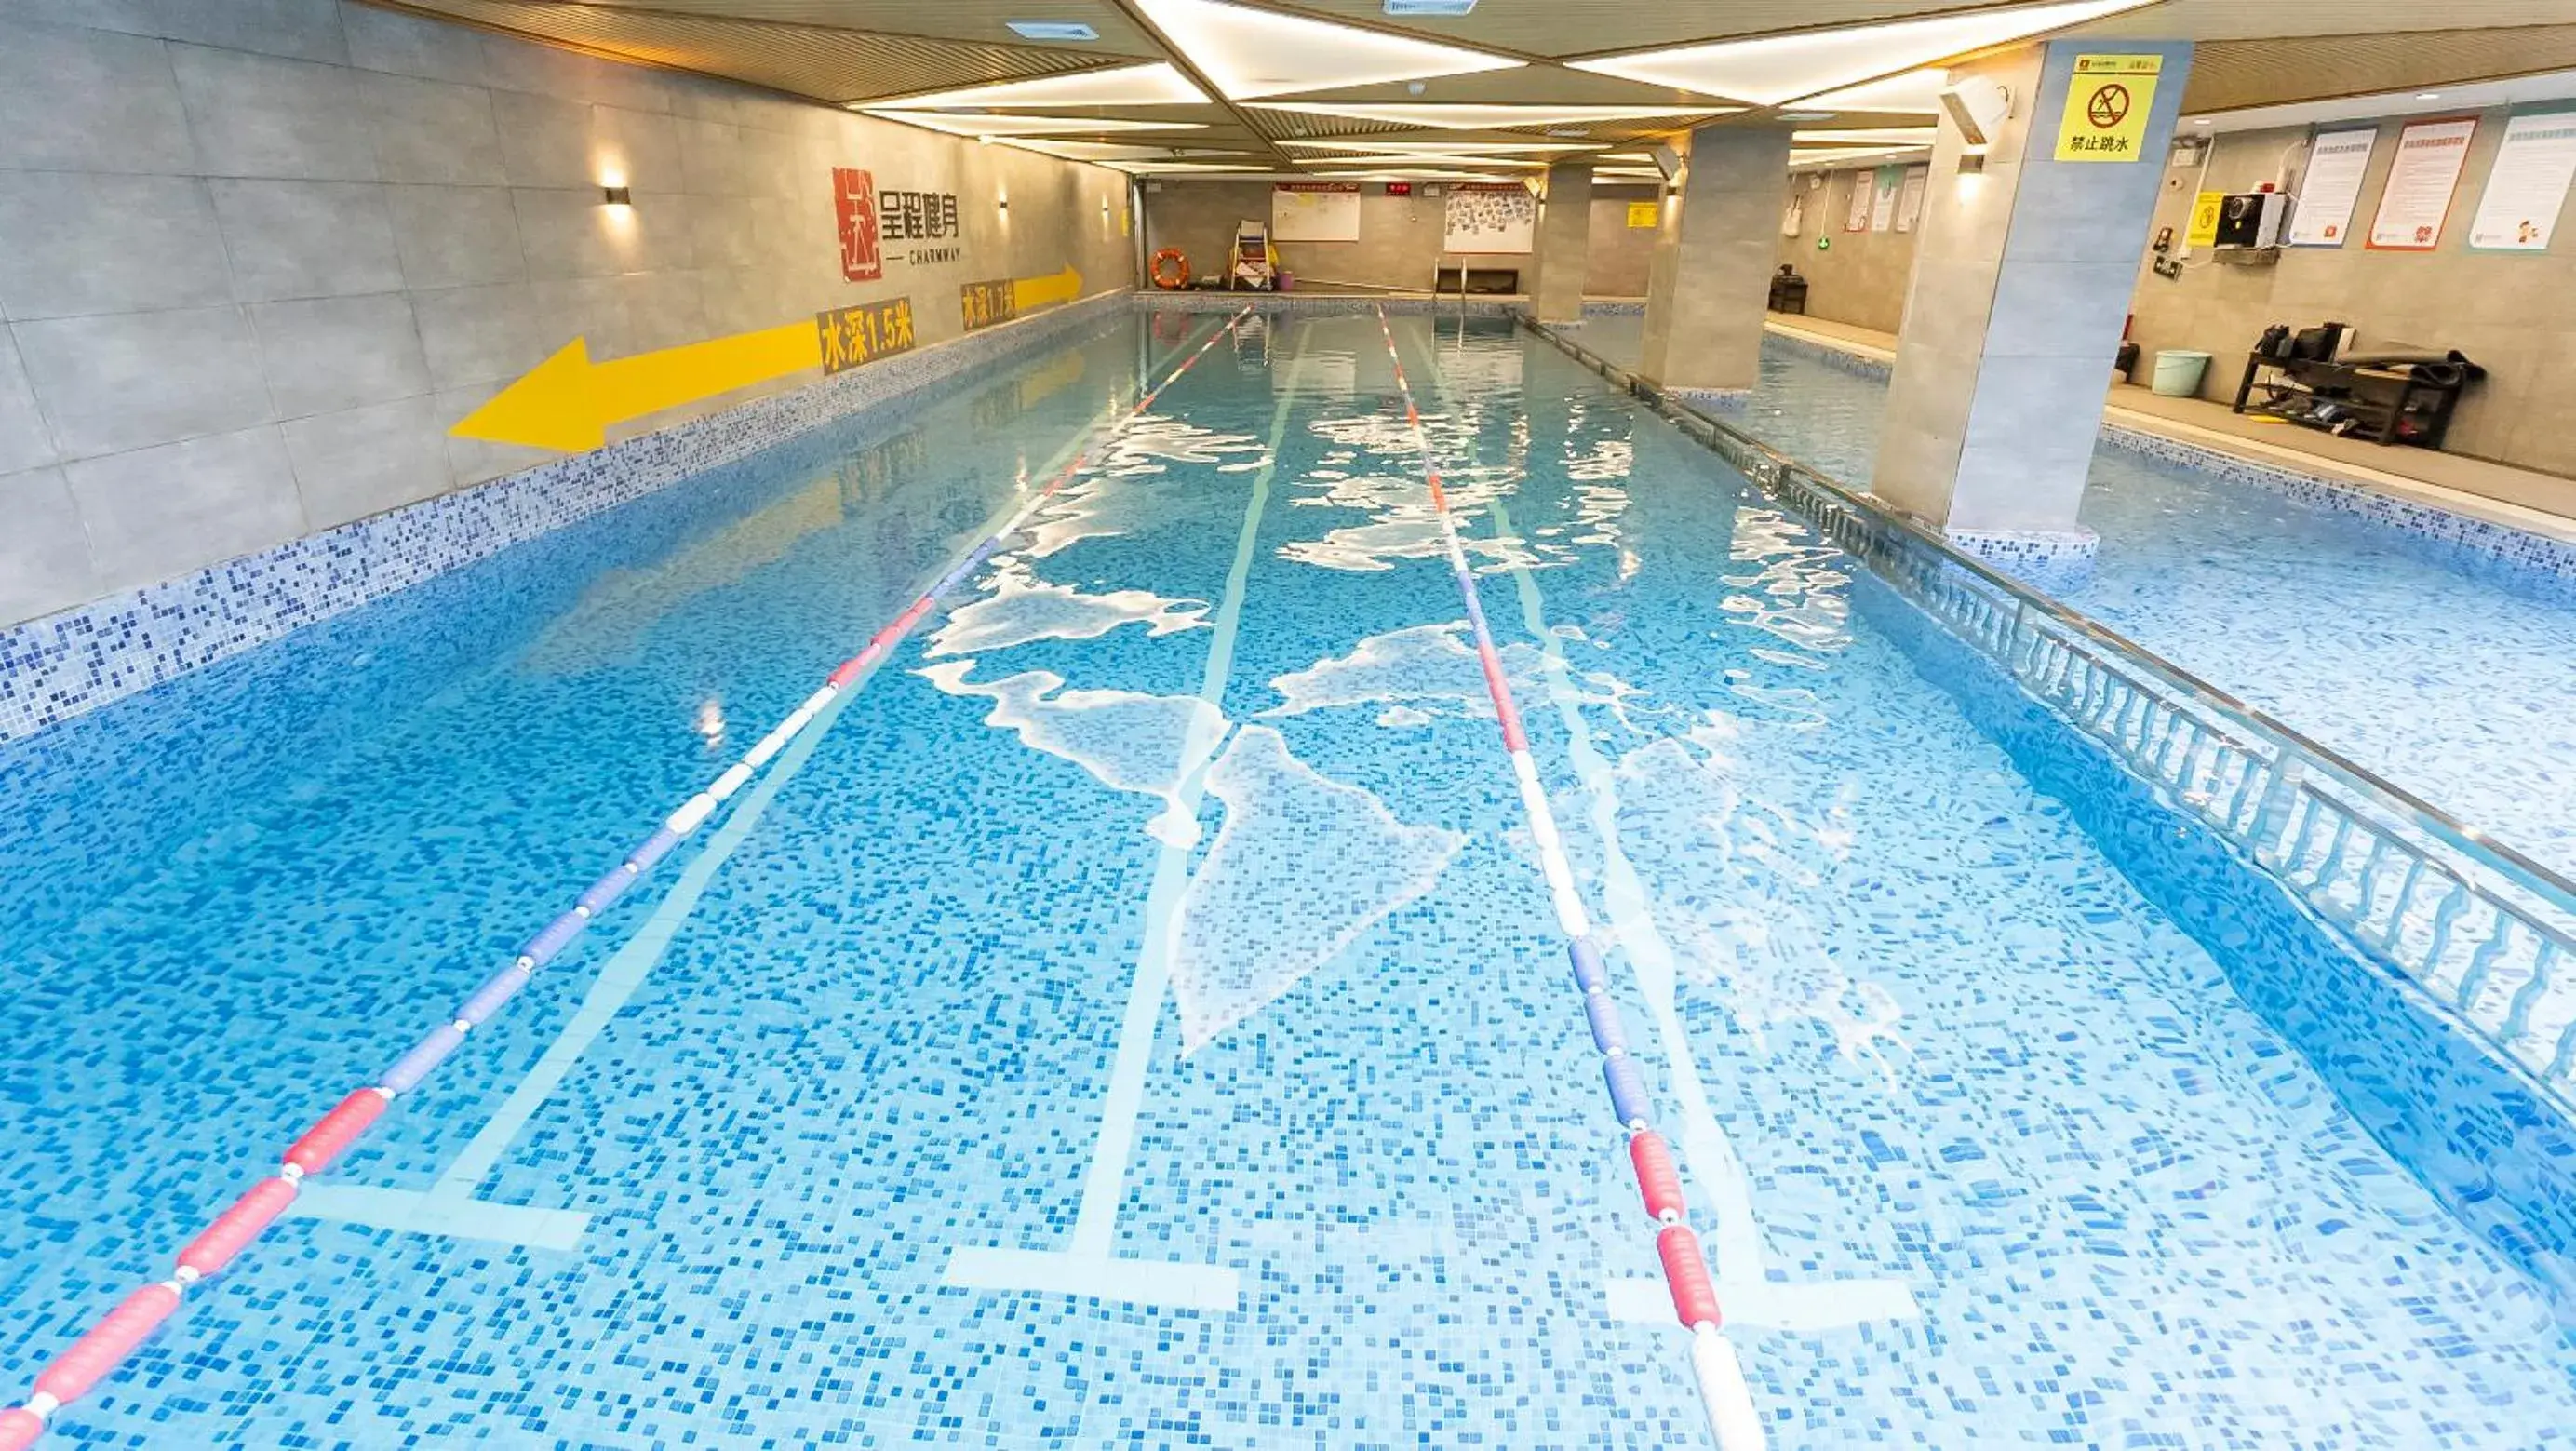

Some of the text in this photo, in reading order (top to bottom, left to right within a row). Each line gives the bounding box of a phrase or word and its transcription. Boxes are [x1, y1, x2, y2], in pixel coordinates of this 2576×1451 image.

[2070, 135, 2129, 152] 禁止跳水
[879, 190, 959, 240] 呈程健身
[908, 247, 960, 266] CHARMWAY
[962, 280, 1016, 328] 水深1.7米
[822, 298, 913, 371] 水深1.5米
